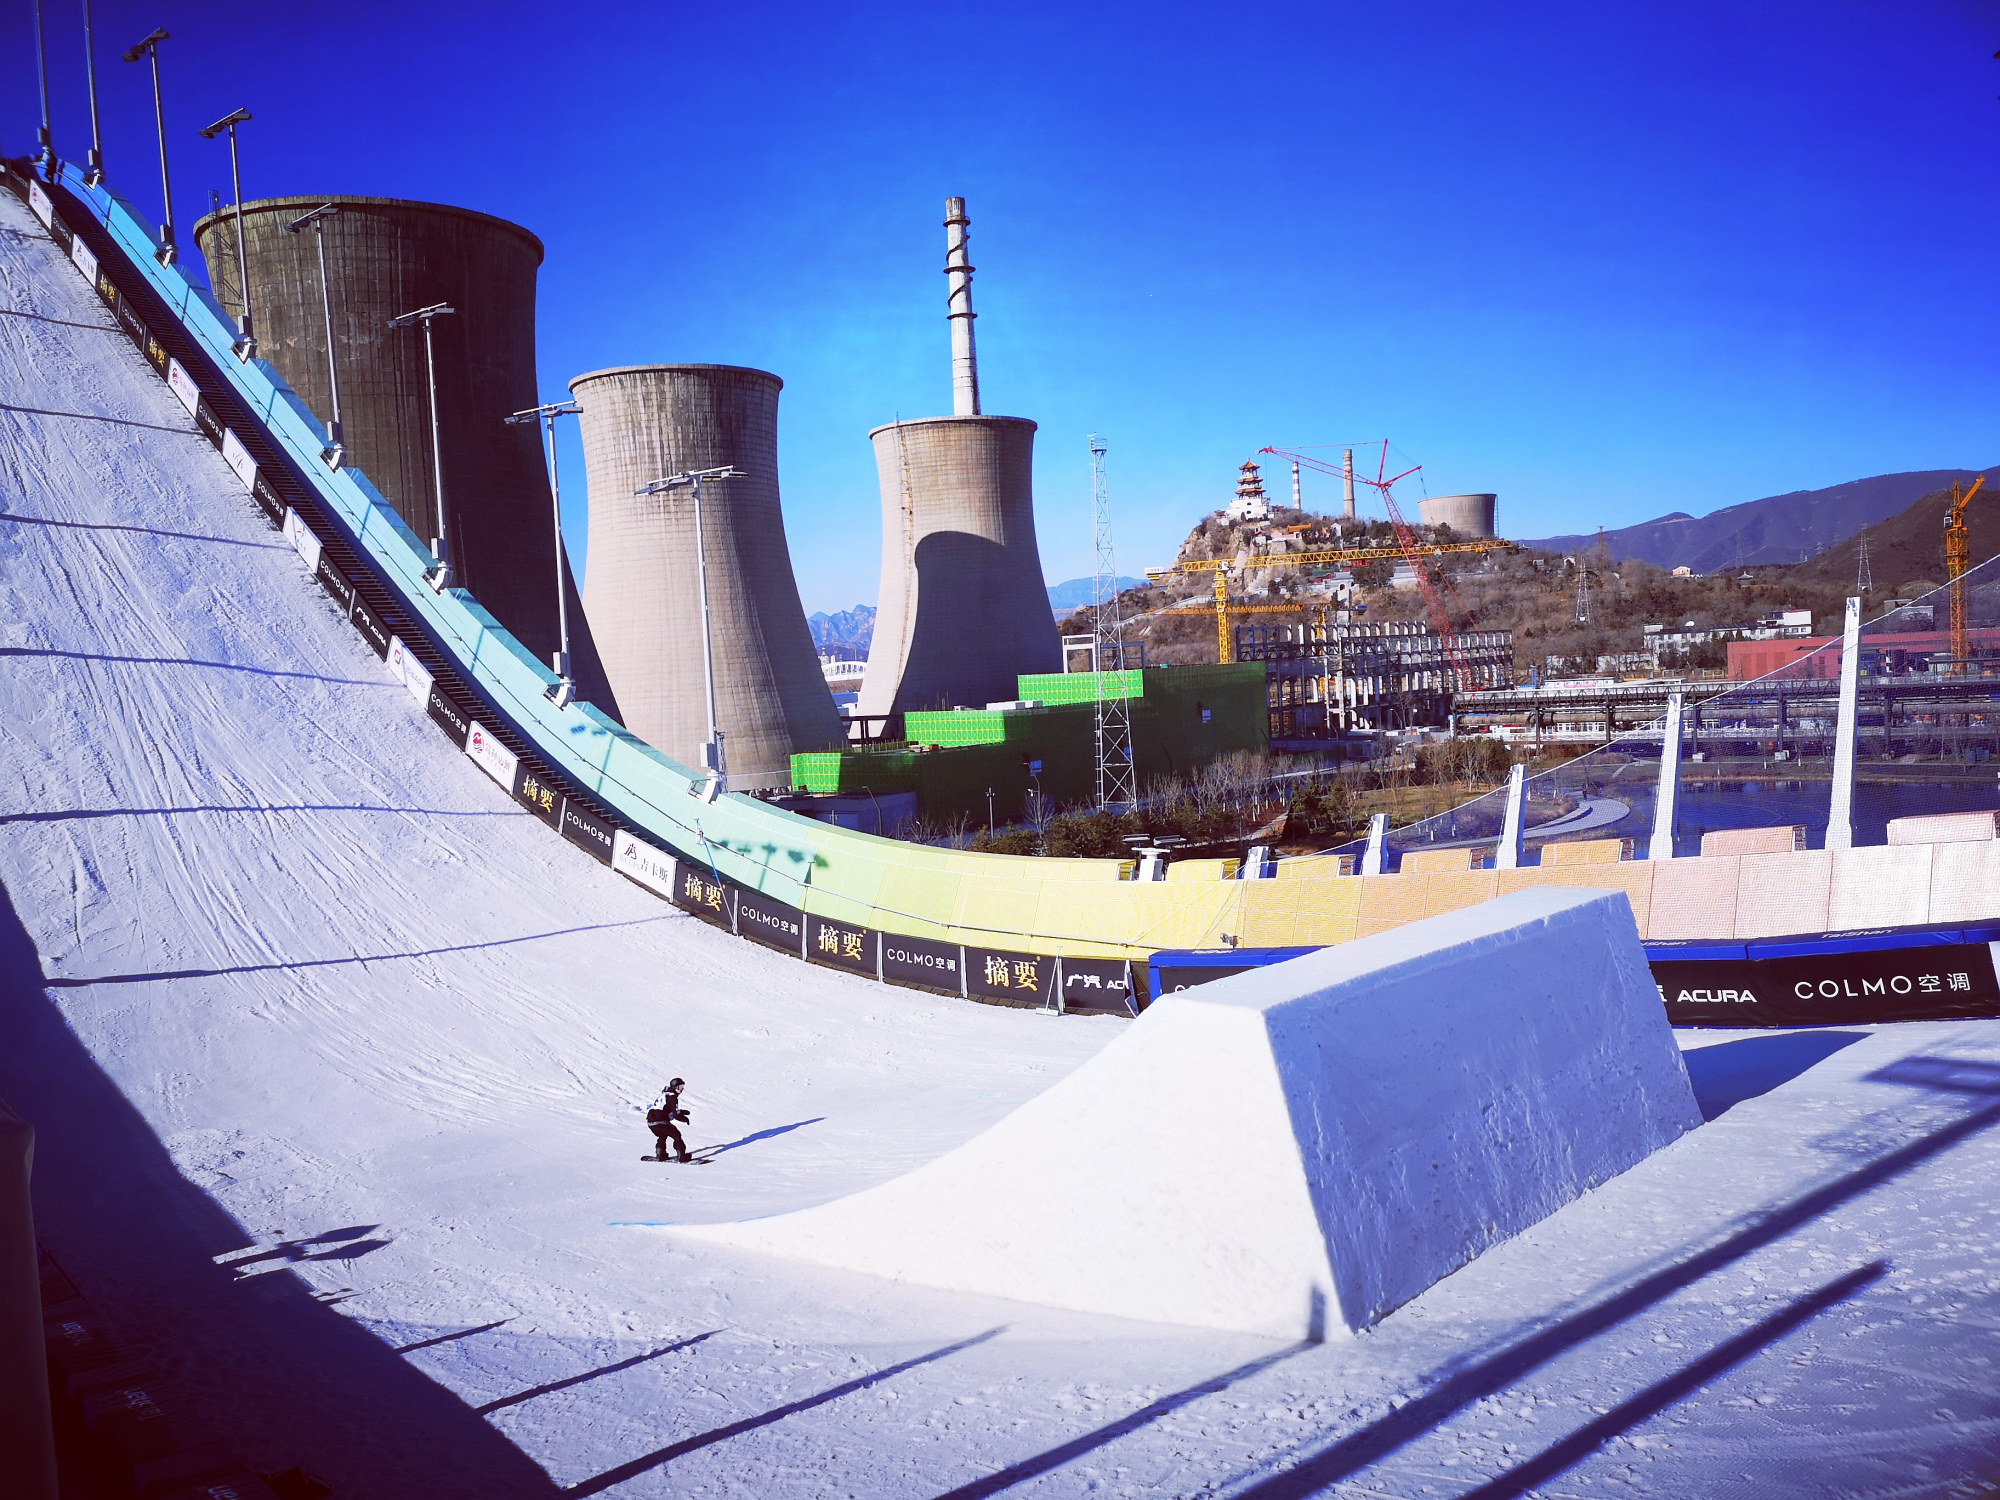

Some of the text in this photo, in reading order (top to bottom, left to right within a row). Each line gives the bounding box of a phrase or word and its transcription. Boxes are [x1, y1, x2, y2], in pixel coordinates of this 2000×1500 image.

[684, 873, 723, 912] 摘要
[818, 923, 865, 961] 摘要
[984, 955, 1039, 992] 摘要
[1065, 973, 1103, 989] 广汽
[1677, 989, 1757, 1003] ACURA
